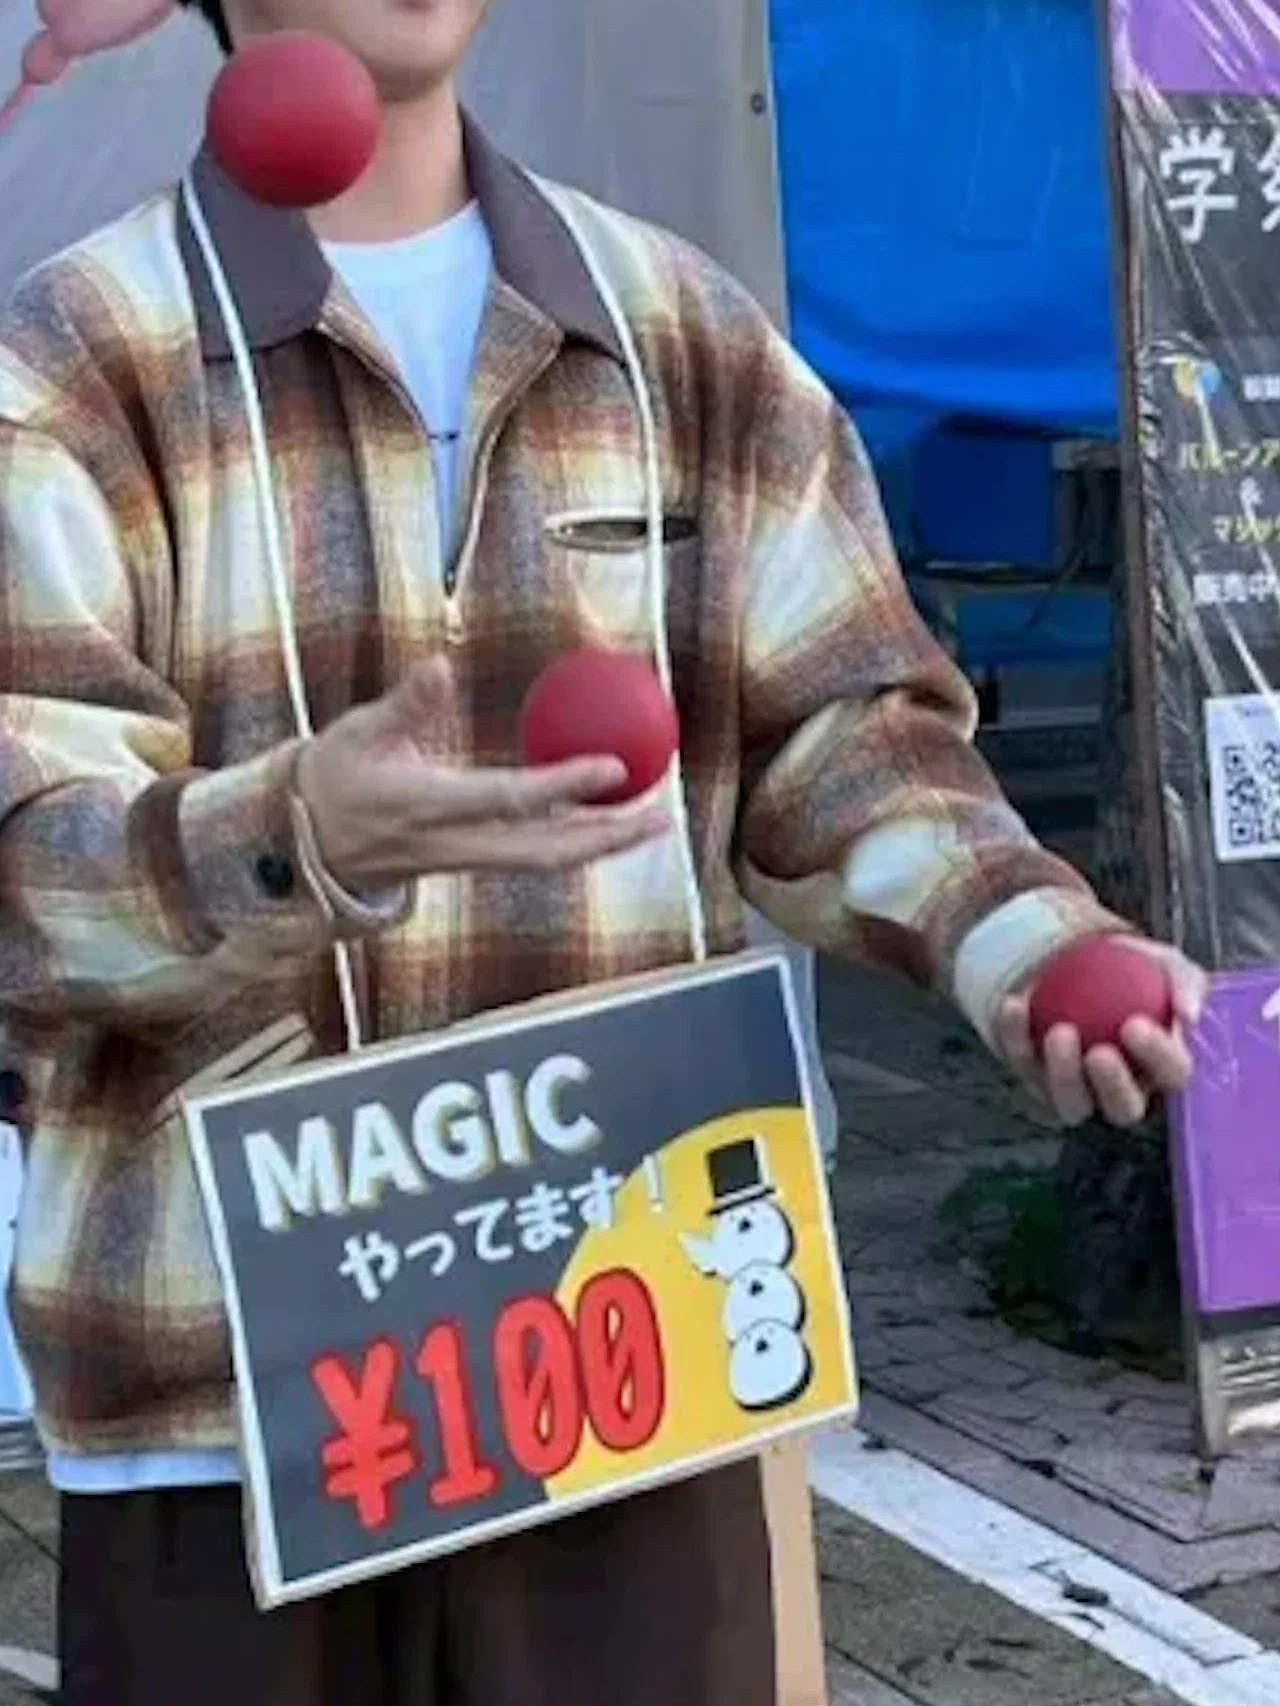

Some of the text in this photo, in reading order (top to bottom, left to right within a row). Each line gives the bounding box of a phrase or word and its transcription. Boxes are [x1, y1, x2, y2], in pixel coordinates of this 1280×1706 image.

[242, 1052, 604, 1233] MAGIC
[339, 1154, 668, 1302] やってます!
[309, 1265, 667, 1533] ¥100
